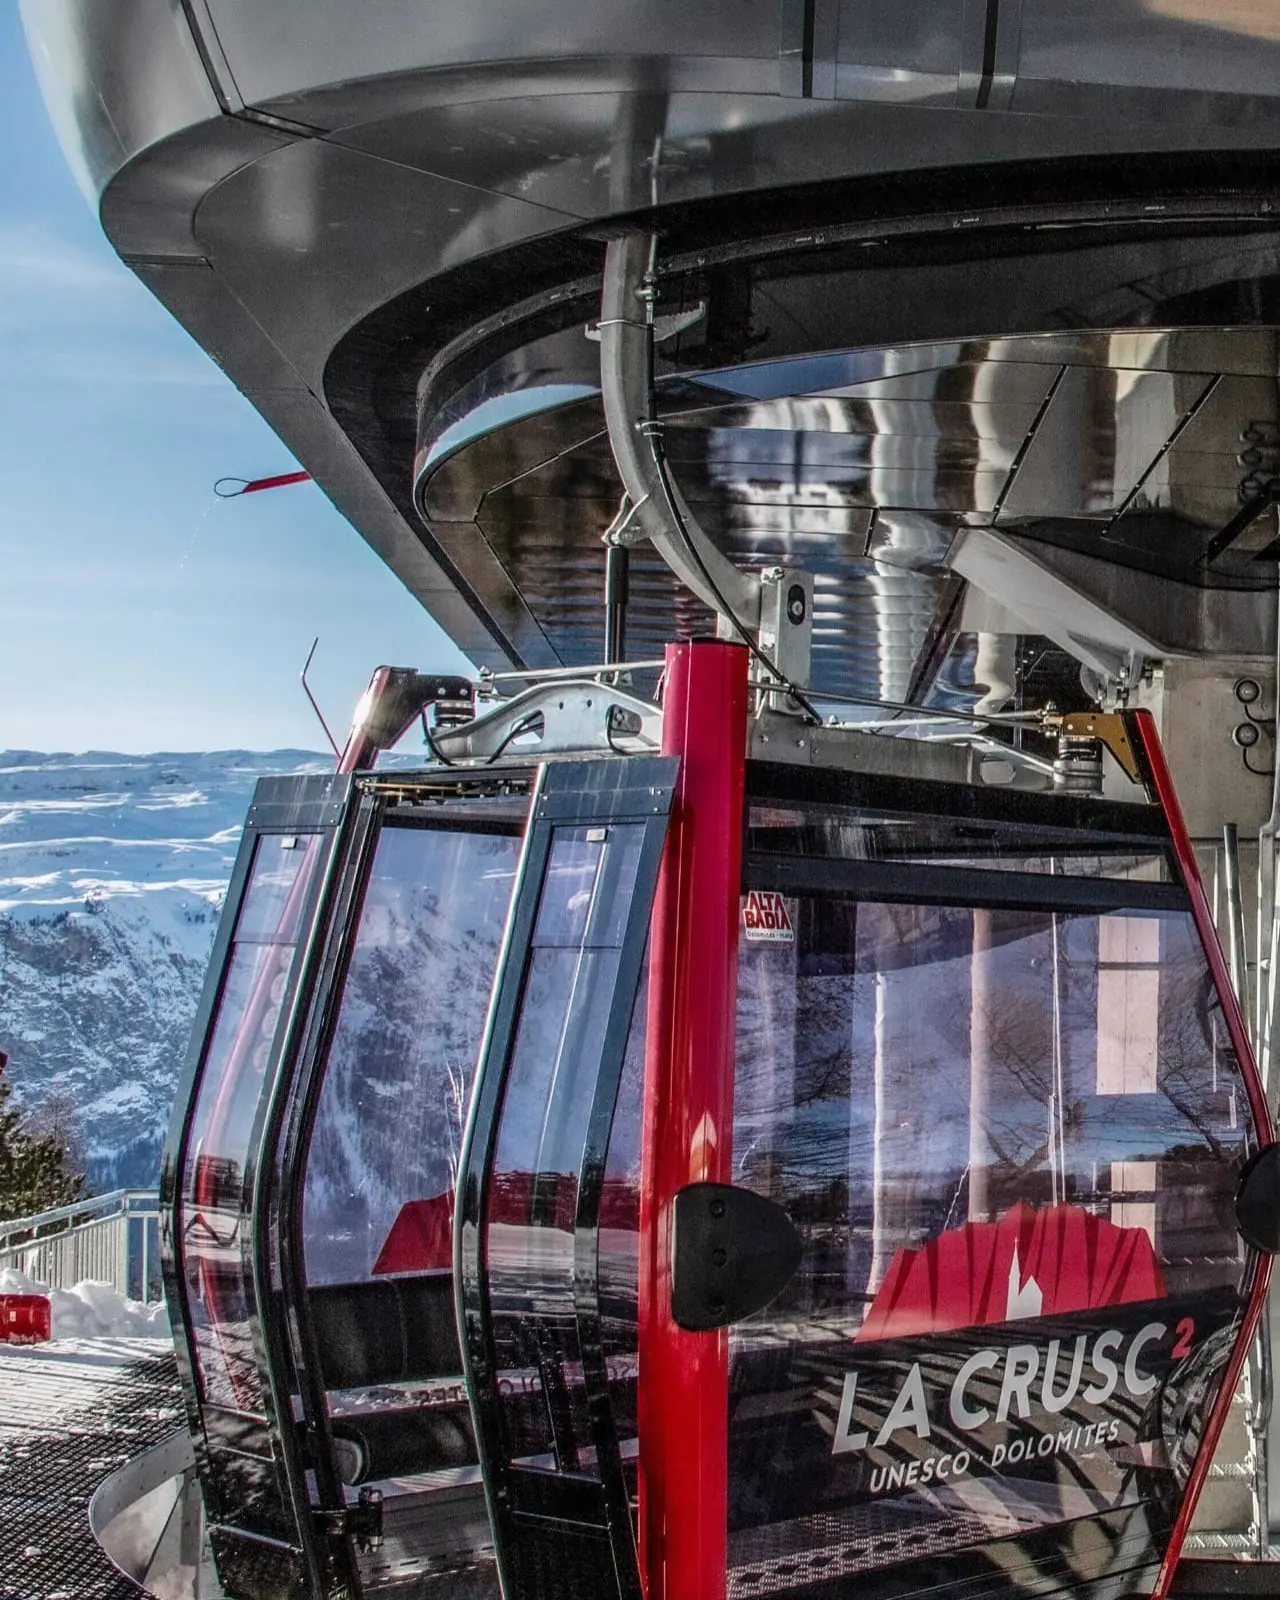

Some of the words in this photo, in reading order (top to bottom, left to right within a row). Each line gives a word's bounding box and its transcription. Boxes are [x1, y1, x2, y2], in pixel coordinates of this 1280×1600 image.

[744, 910, 792, 929] BADIA
[749, 892, 785, 911] ALTA
[832, 1362, 931, 1455] LA
[870, 1450, 972, 1492] UNESCO
[991, 1420, 1120, 1466] DOLOMITES
